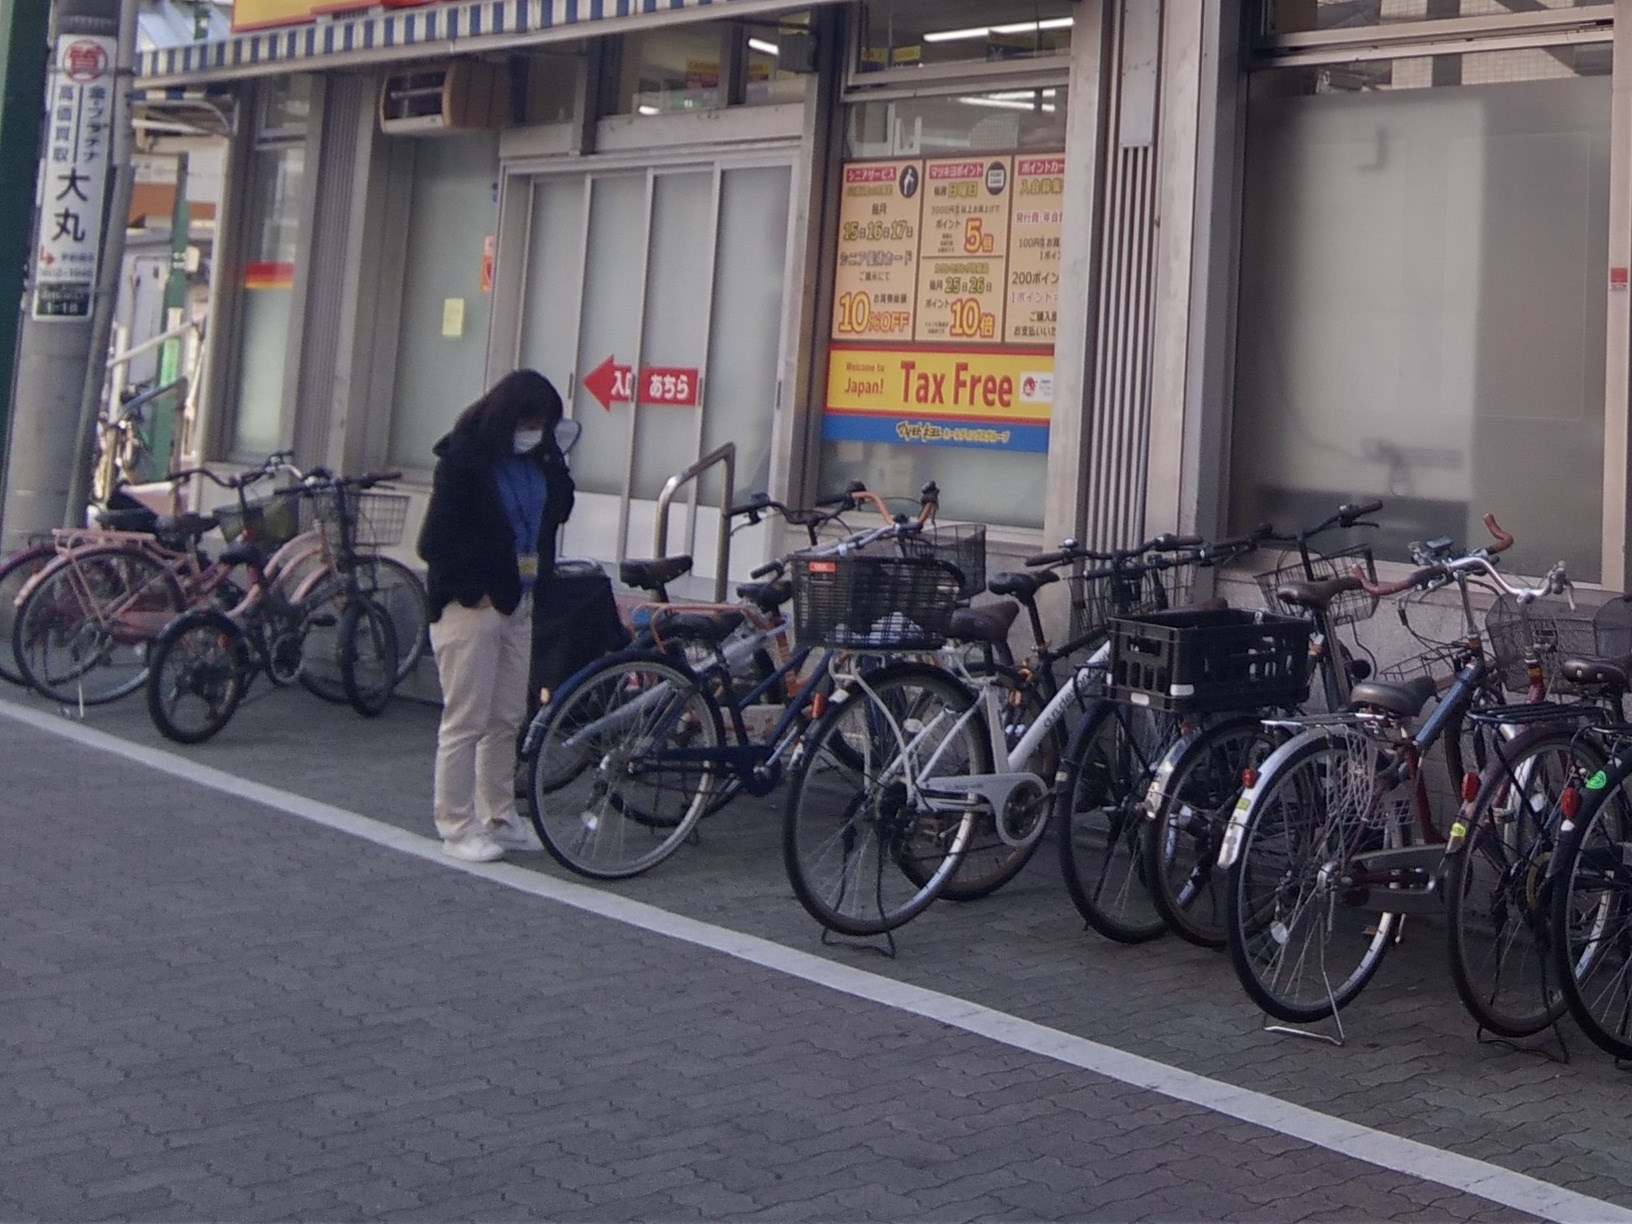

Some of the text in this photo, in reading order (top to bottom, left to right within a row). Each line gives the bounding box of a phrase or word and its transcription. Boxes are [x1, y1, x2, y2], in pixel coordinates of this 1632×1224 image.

[847, 167, 896, 182] シニアサービス
[51, 166, 91, 243] 大丸
[838, 290, 910, 334] 10%OFF
[844, 377, 885, 398] Japan!
[901, 360, 945, 405] Tax
[952, 362, 1014, 408] Free
